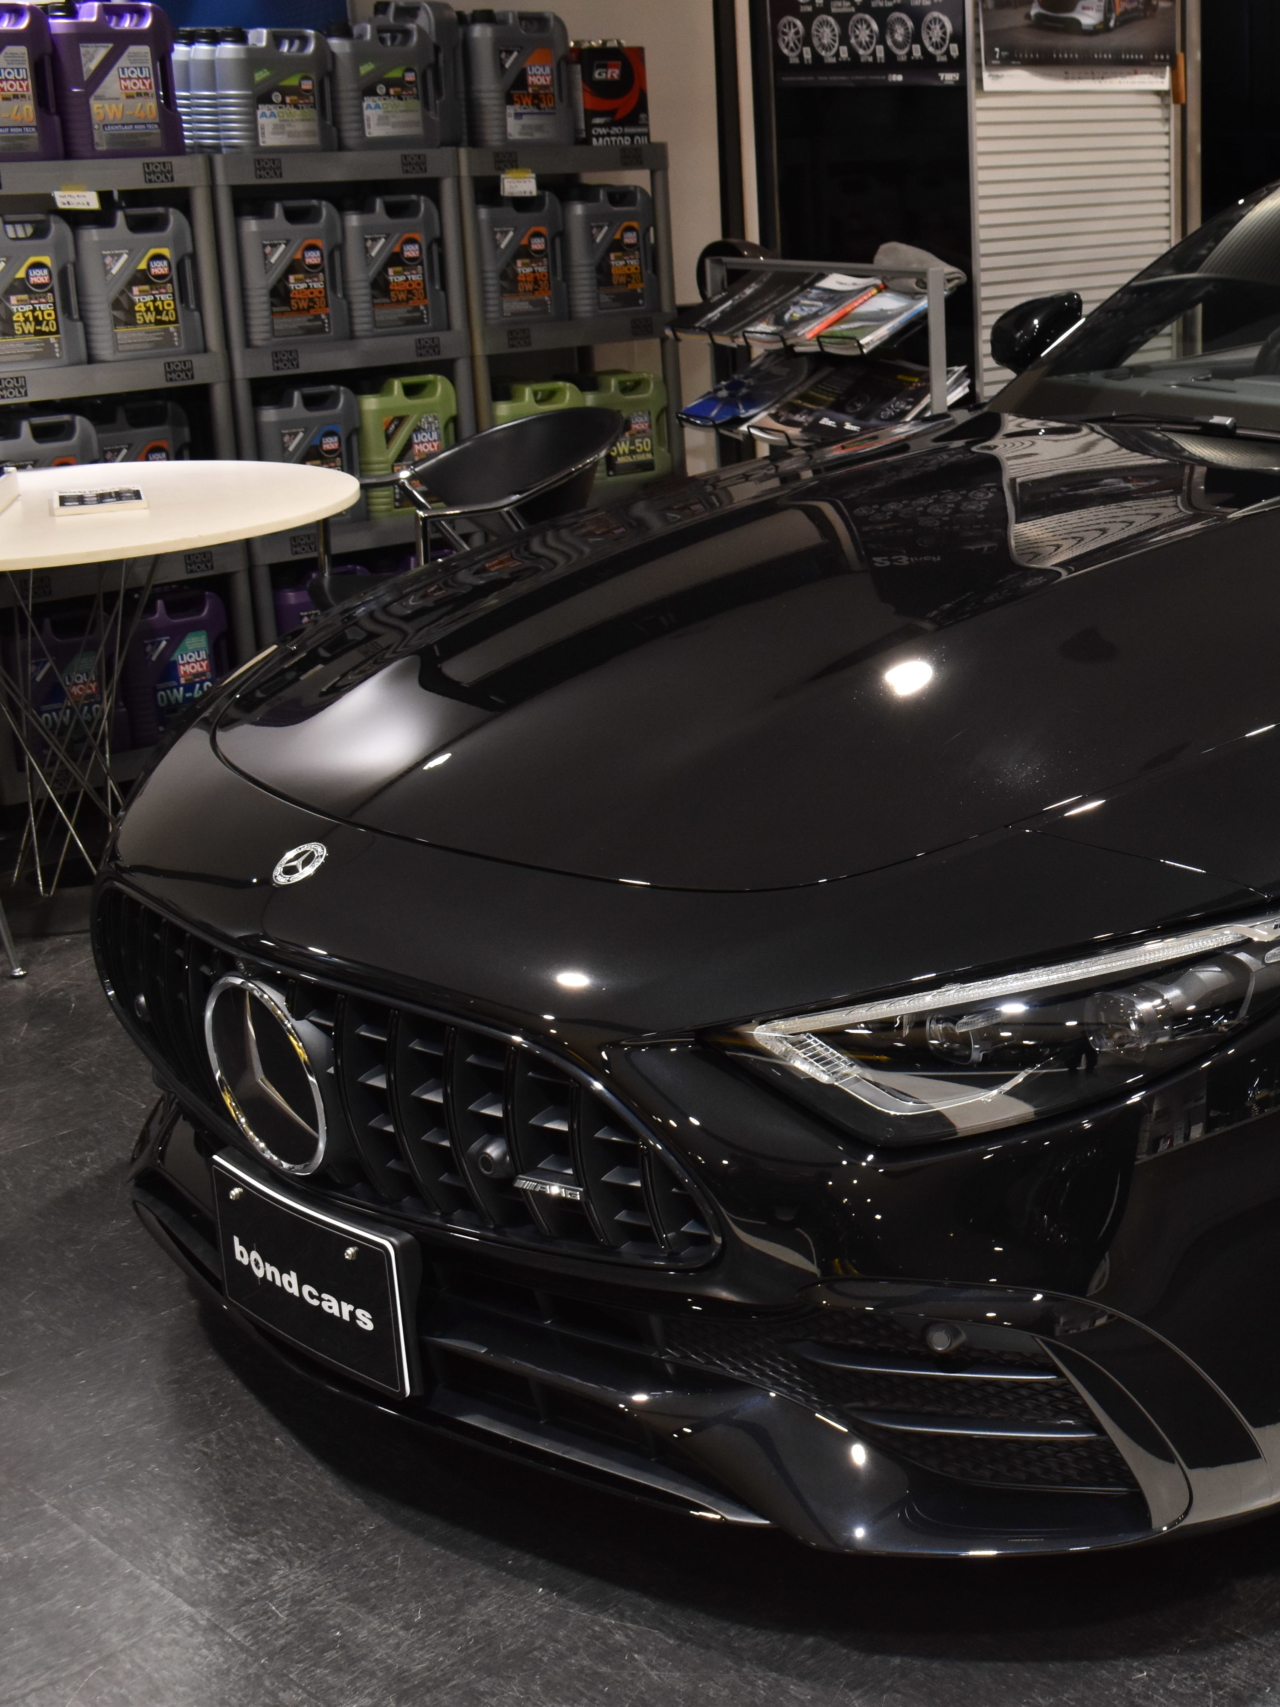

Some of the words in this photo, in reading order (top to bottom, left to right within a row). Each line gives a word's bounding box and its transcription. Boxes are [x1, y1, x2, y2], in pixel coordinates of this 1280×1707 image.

[0, 68, 27, 80] IQUI
[118, 67, 150, 78] LIQUI
[527, 66, 551, 75] LIQUI
[594, 68, 620, 80] GR
[120, 79, 152, 90] MOLY
[528, 75, 552, 85] MOLY
[513, 93, 555, 107] 5W-30
[92, 102, 157, 121] 5W-40
[255, 159, 281, 168] LIQUI
[402, 155, 426, 163] LIQUI
[145, 162, 172, 172] LIQUI
[403, 164, 427, 173] MOLY
[146, 172, 174, 182] MOLY
[256, 169, 282, 178] MOLY
[150, 259, 168, 267] LIQUI
[28, 268, 48, 276] LIQUI
[151, 267, 170, 275] MOLY
[30, 276, 51, 284] MOLY
[290, 288, 326, 298] 4200
[134, 300, 175, 312] 4110
[290, 297, 326, 311] 5W-30
[12, 310, 56, 322] 4110
[136, 310, 176, 324] 5W-40
[14, 320, 57, 335] 5W-40
[272, 350, 298, 360] LIQUI
[165, 360, 192, 371] LIQUI
[274, 360, 299, 370] MOLY
[166, 371, 194, 381] MOLY
[321, 435, 338, 443] LIQUI
[412, 430, 438, 442] LIQUI
[414, 441, 440, 453] MOLY
[148, 451, 168, 460] LIQUI
[291, 535, 316, 546] LIQUI
[292, 544, 318, 554] MOLY
[185, 552, 212, 563] LIQUI
[187, 562, 214, 573] MOLY
[178, 650, 207, 664] LIQUI
[180, 660, 209, 675] MOLY
[233, 1235, 374, 1331] bondcars
